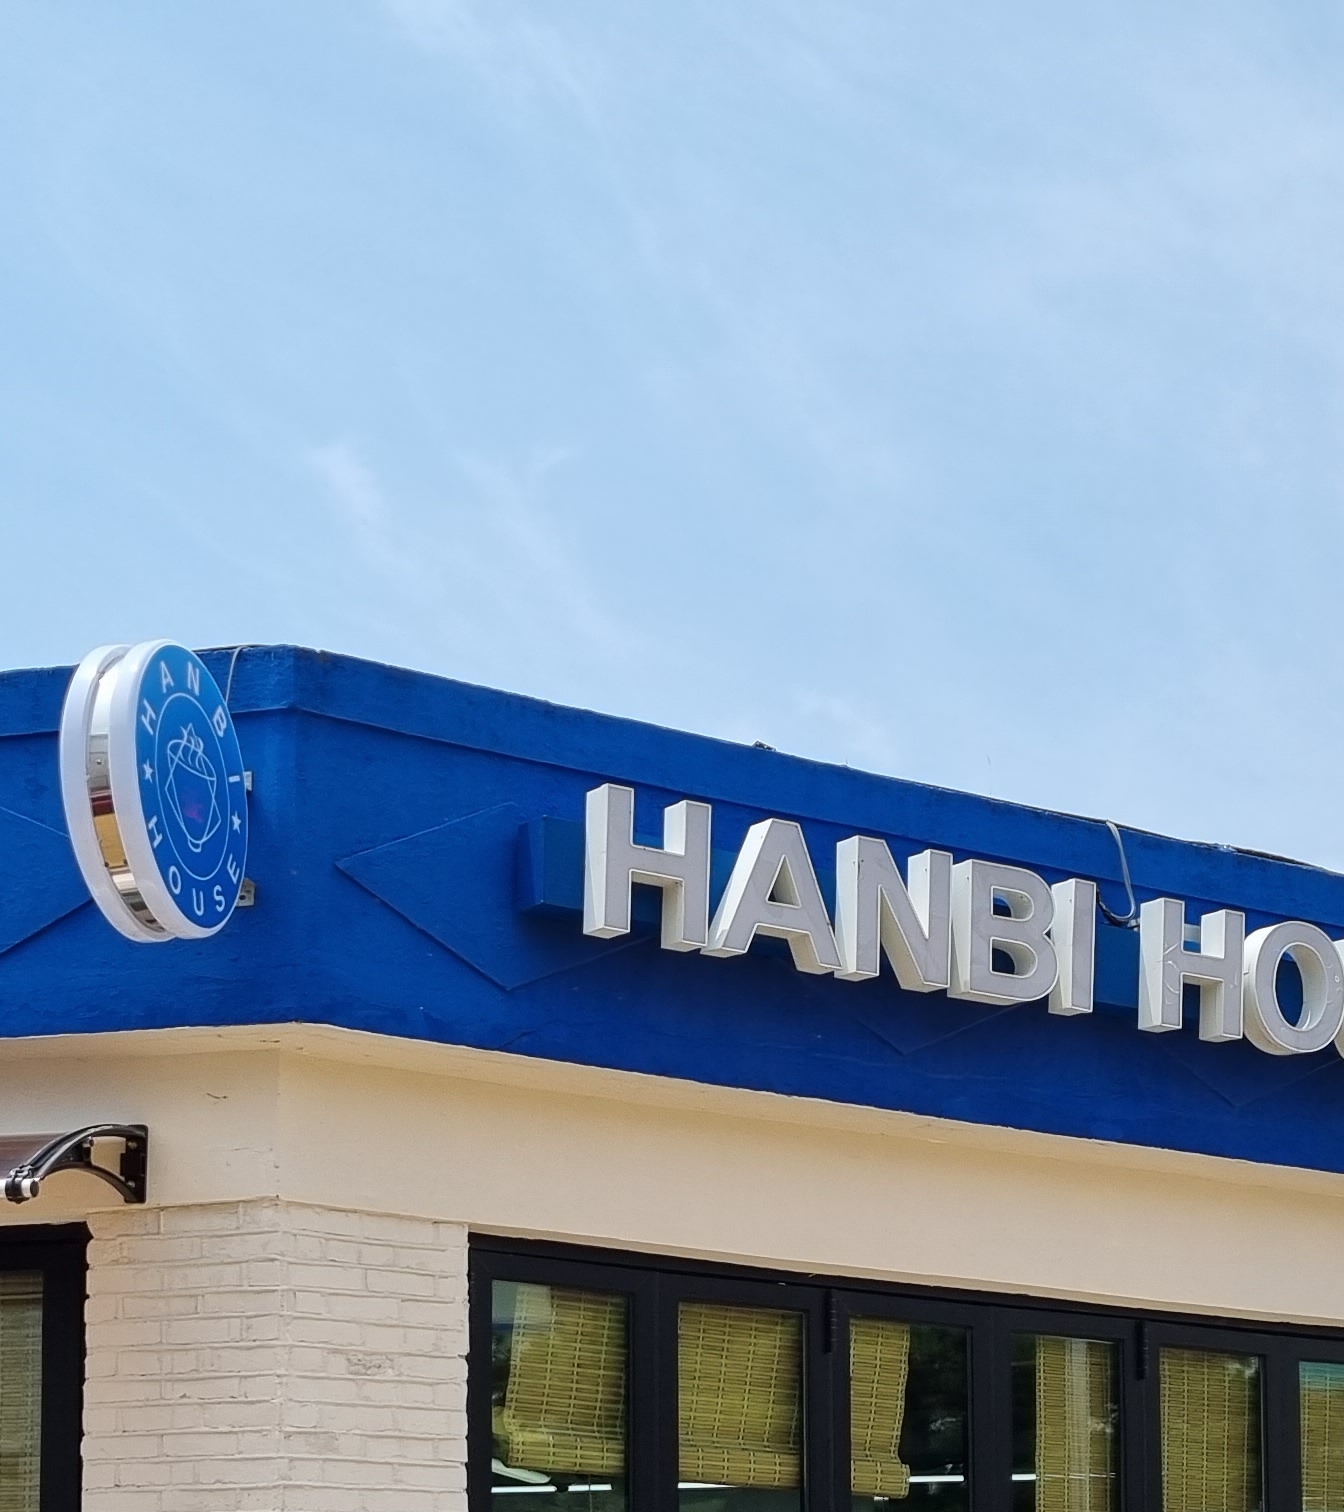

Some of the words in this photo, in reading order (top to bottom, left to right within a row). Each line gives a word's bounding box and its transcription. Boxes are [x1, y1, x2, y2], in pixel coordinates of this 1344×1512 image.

[142, 661, 240, 783] HANBI
[148, 816, 240, 916] HOUSE
[583, 783, 1096, 1017] HANBI
